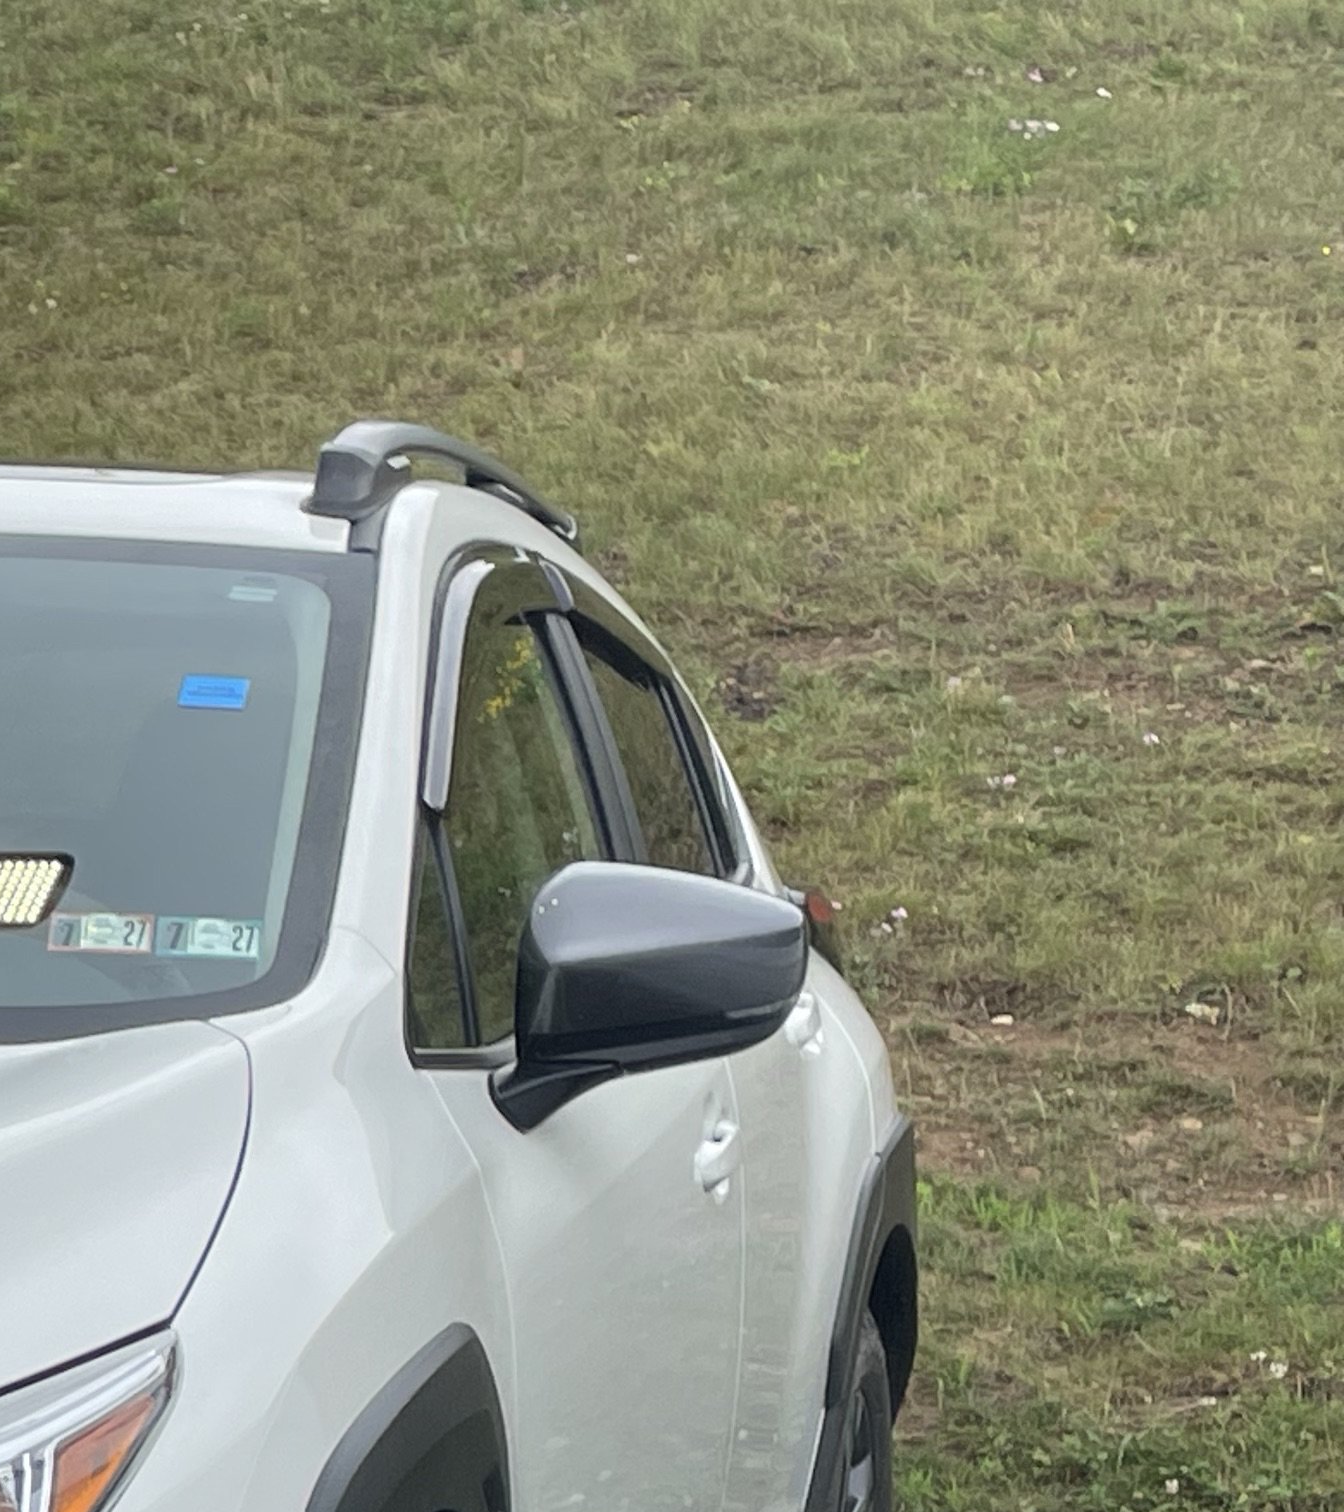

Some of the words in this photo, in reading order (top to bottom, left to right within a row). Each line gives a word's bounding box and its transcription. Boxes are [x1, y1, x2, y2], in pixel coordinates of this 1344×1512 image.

[59, 922, 75, 947] 7
[122, 920, 147, 949] 27
[166, 922, 185, 950] 7
[231, 925, 255, 954] 27
